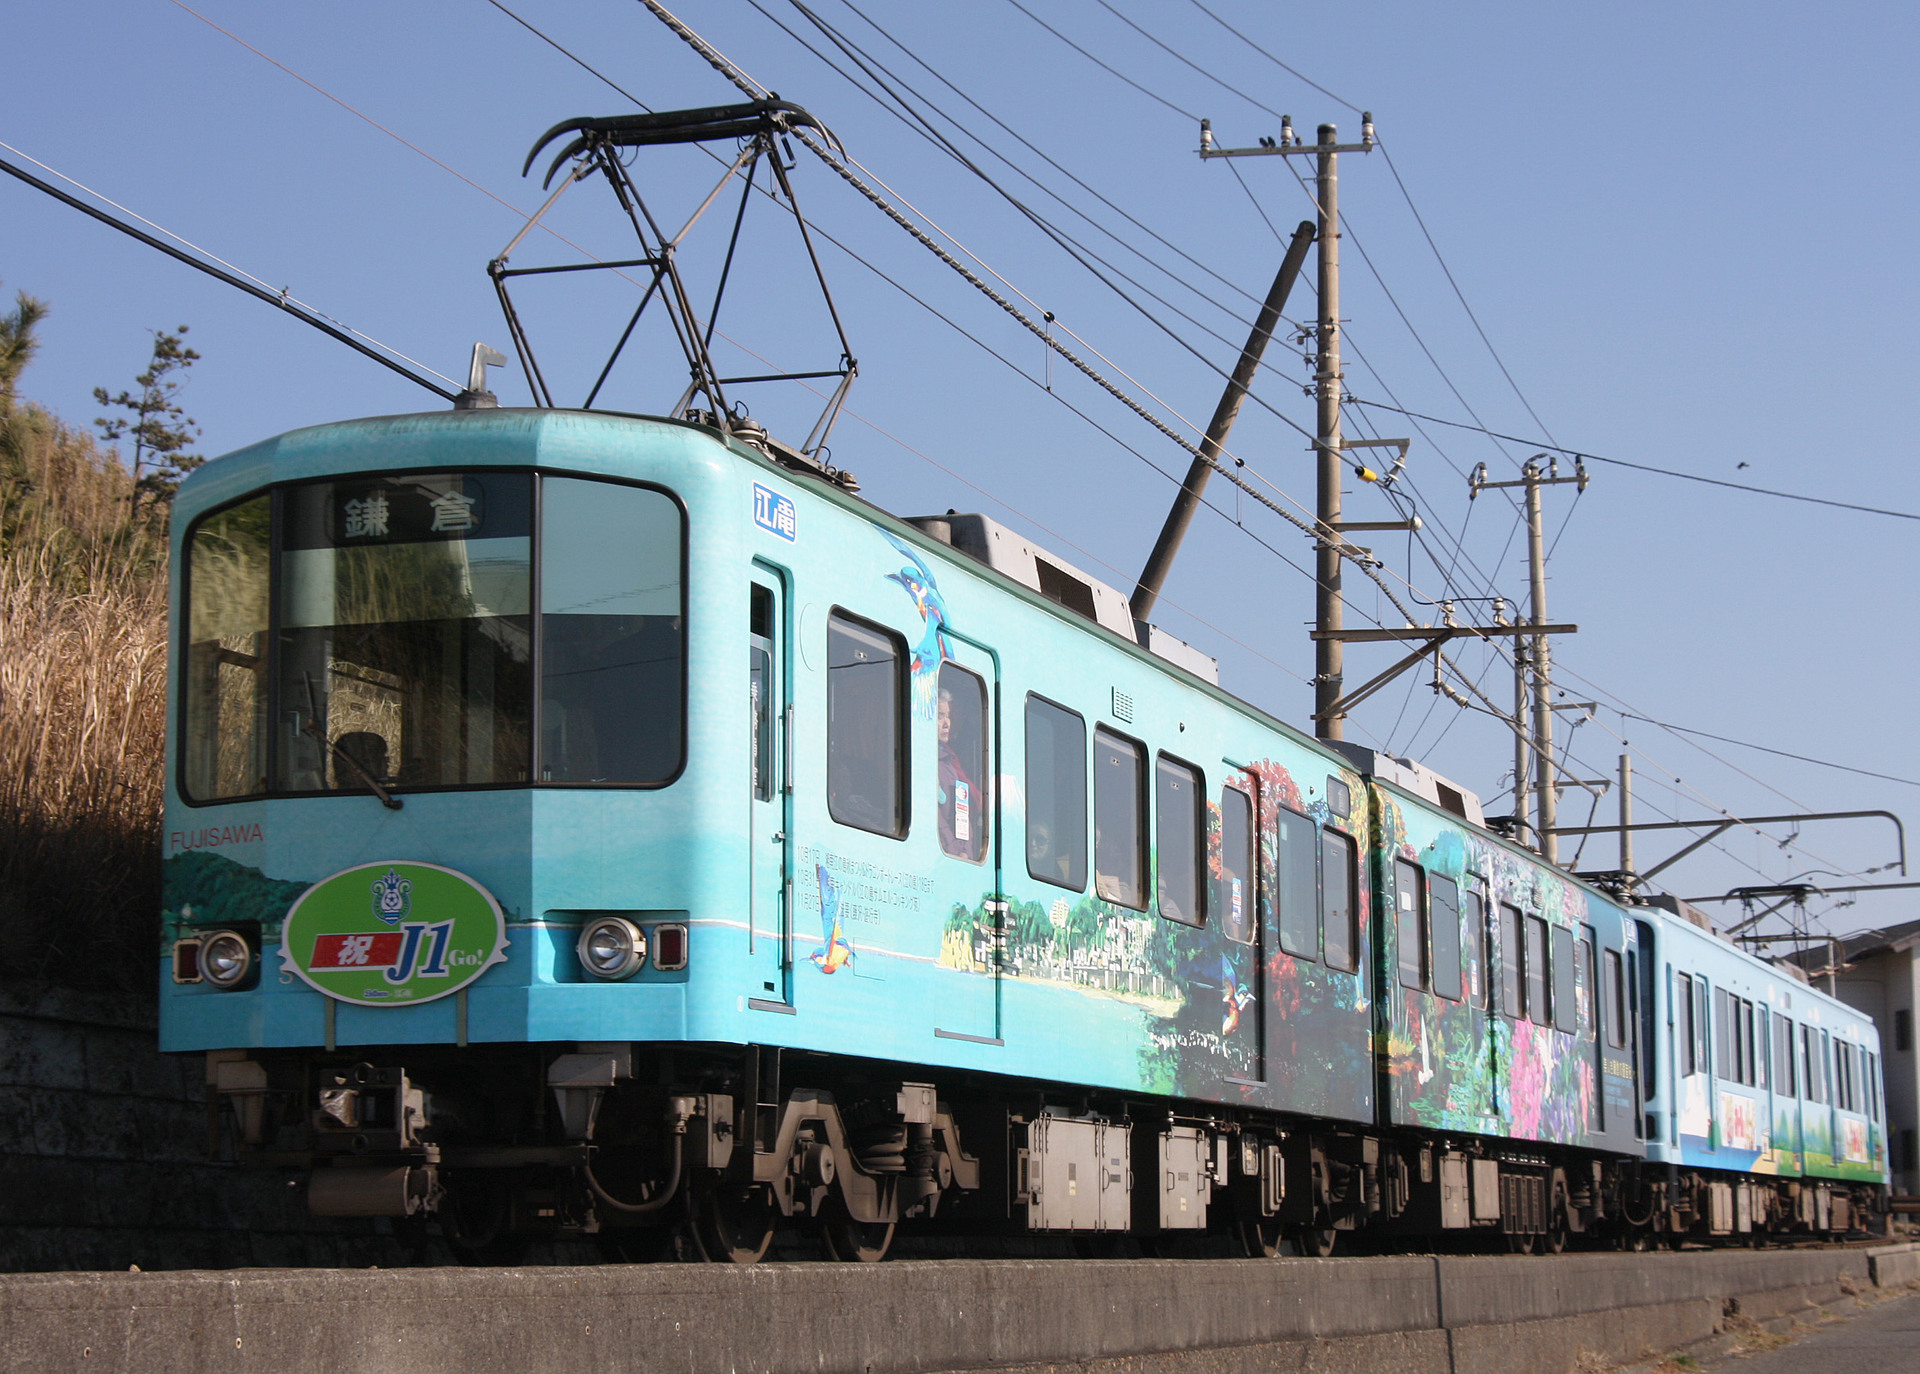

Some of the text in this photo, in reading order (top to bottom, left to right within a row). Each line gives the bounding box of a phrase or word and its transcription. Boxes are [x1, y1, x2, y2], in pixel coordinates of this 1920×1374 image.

[343, 490, 476, 538] 鎌倉
[170, 823, 265, 851] FUJISAWA
[338, 921, 484, 983] 祝 J1 Go!
